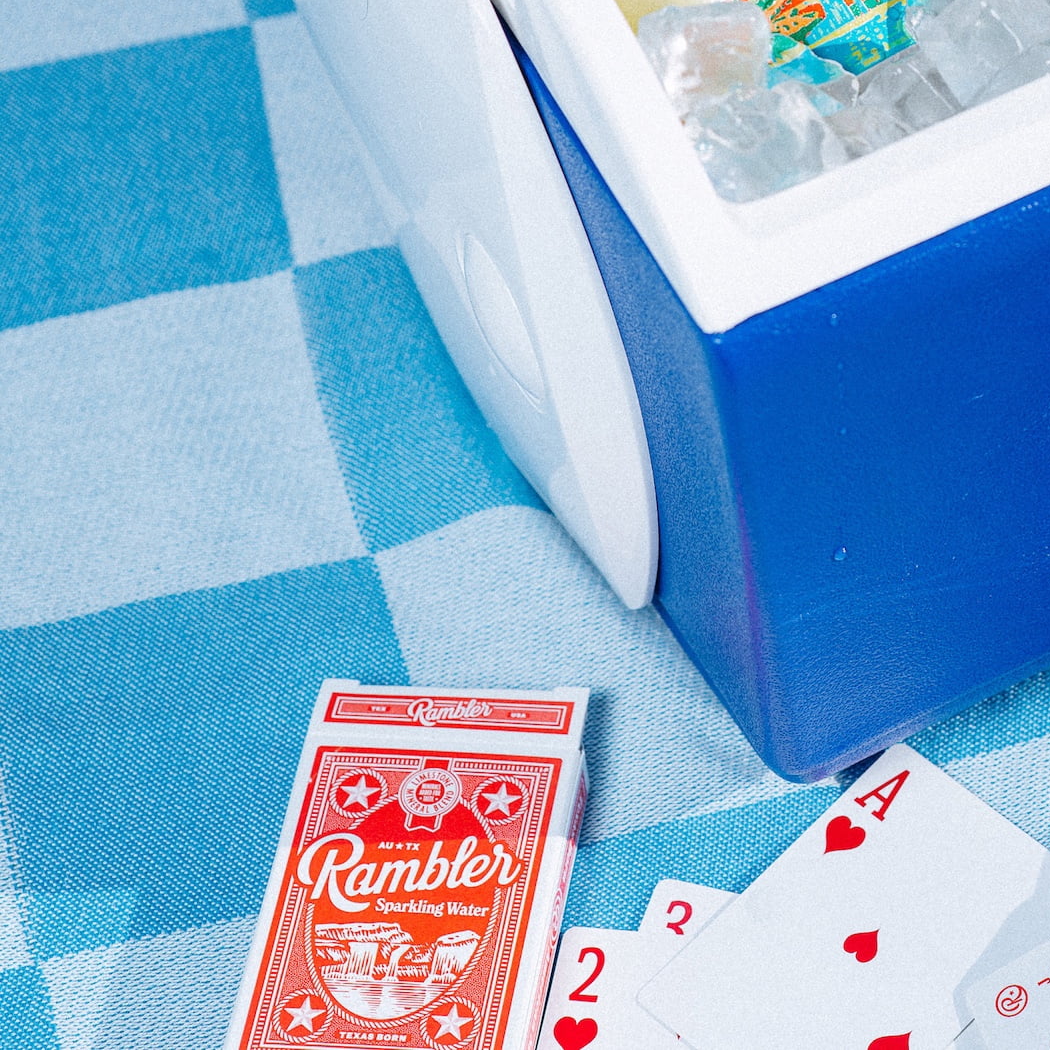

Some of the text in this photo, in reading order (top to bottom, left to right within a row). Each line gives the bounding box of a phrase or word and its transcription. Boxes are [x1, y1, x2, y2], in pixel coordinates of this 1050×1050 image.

[407, 698, 493, 726] Rambler
[411, 772, 454, 787] LIMESTONE
[854, 769, 910, 821] A
[378, 841, 420, 851] AU TX
[297, 832, 521, 913] Rambler
[375, 898, 489, 917] Sparkling Water
[568, 946, 606, 1003] 2
[339, 1031, 407, 1042] TEXAS BORN
